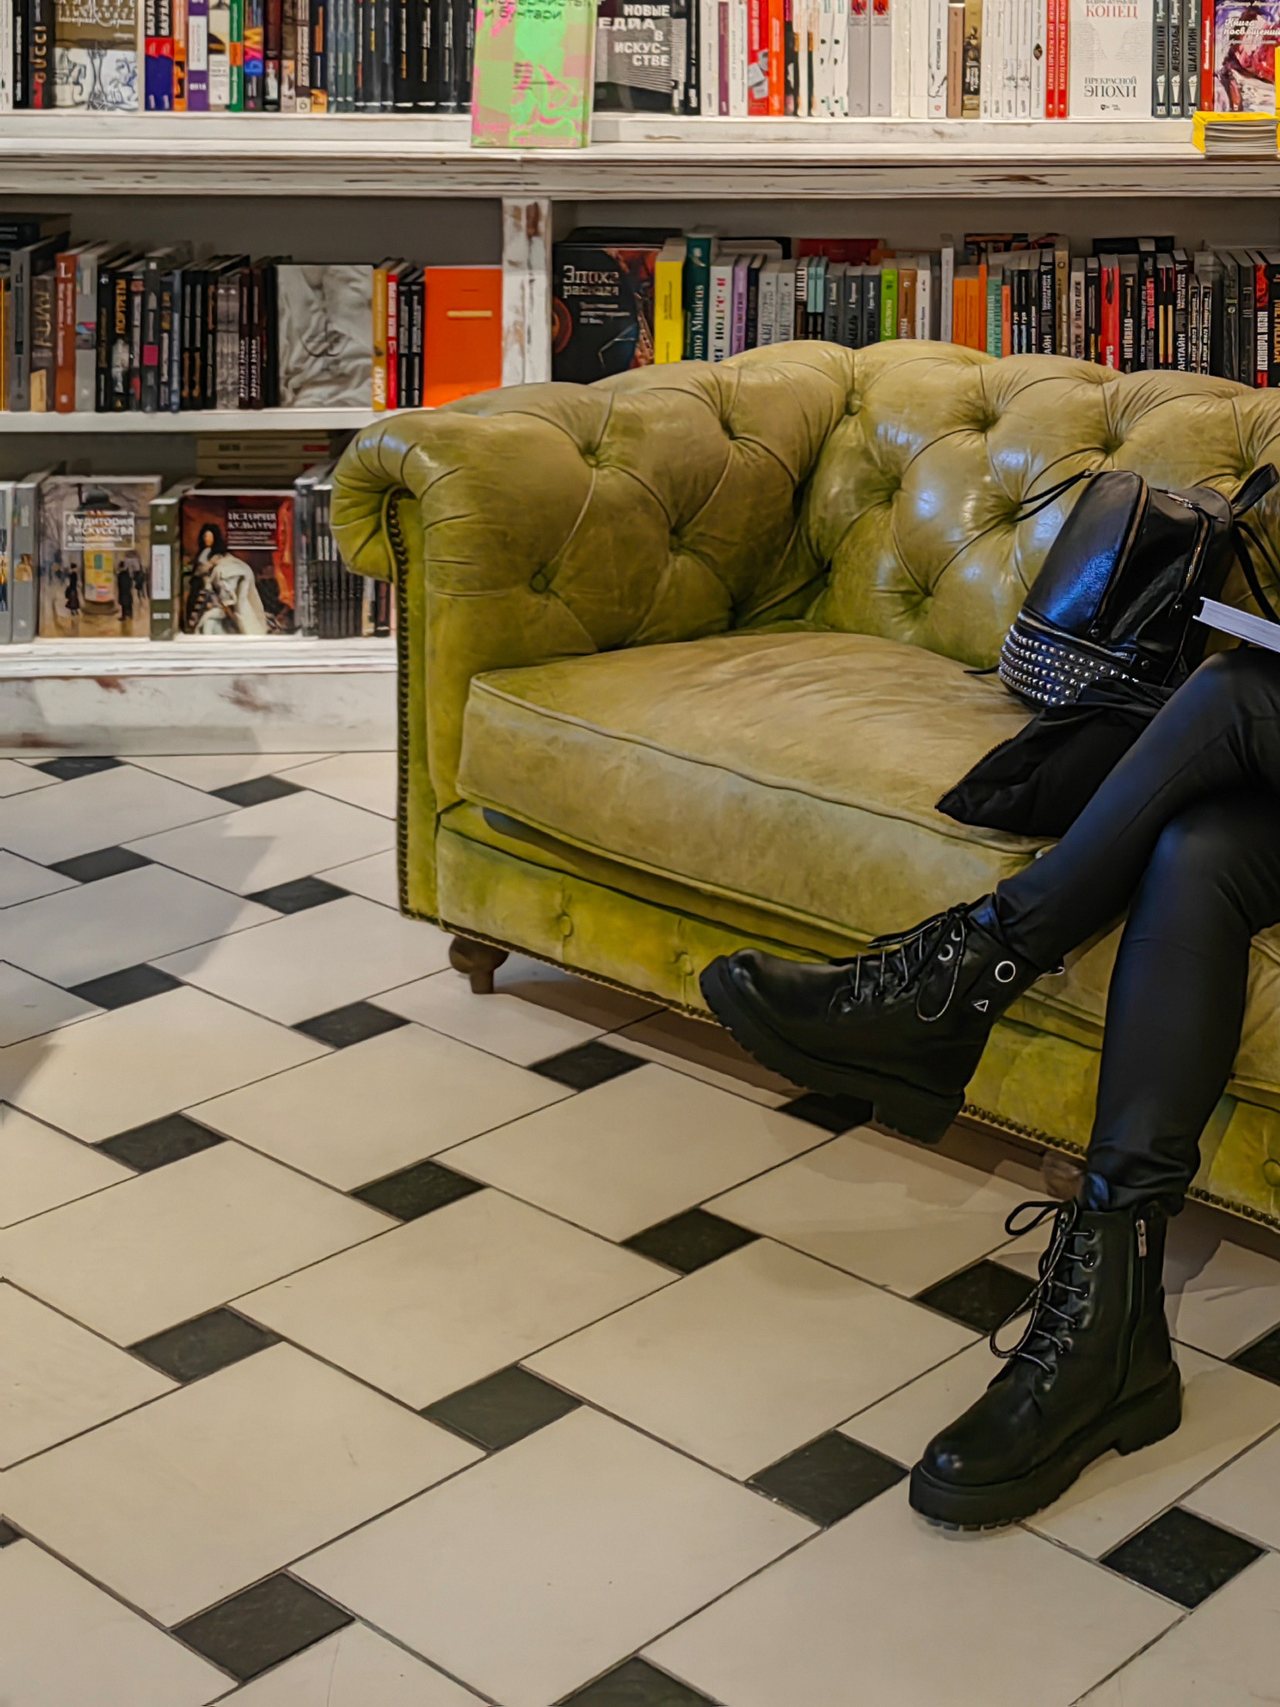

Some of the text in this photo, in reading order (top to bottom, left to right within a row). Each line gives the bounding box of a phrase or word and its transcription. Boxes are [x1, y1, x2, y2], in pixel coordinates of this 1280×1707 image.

[623, 4, 671, 17] НОВЫЕ
[1086, 5, 1138, 19] КОНЕЦ
[599, 17, 656, 31] ЕДИА
[654, 30, 664, 41] В
[613, 42, 669, 54] ИСКУС-
[1189, 28, 1198, 72] ШАЛЯПИН
[632, 55, 671, 67] СТВЕ
[1084, 76, 1138, 85] ПРЕКРАСНОЙ
[1084, 85, 1137, 98] ЭПОХИ
[692, 284, 704, 332] Musicus
[1257, 311, 1268, 371] ЛЕОНАРД КОЭН
